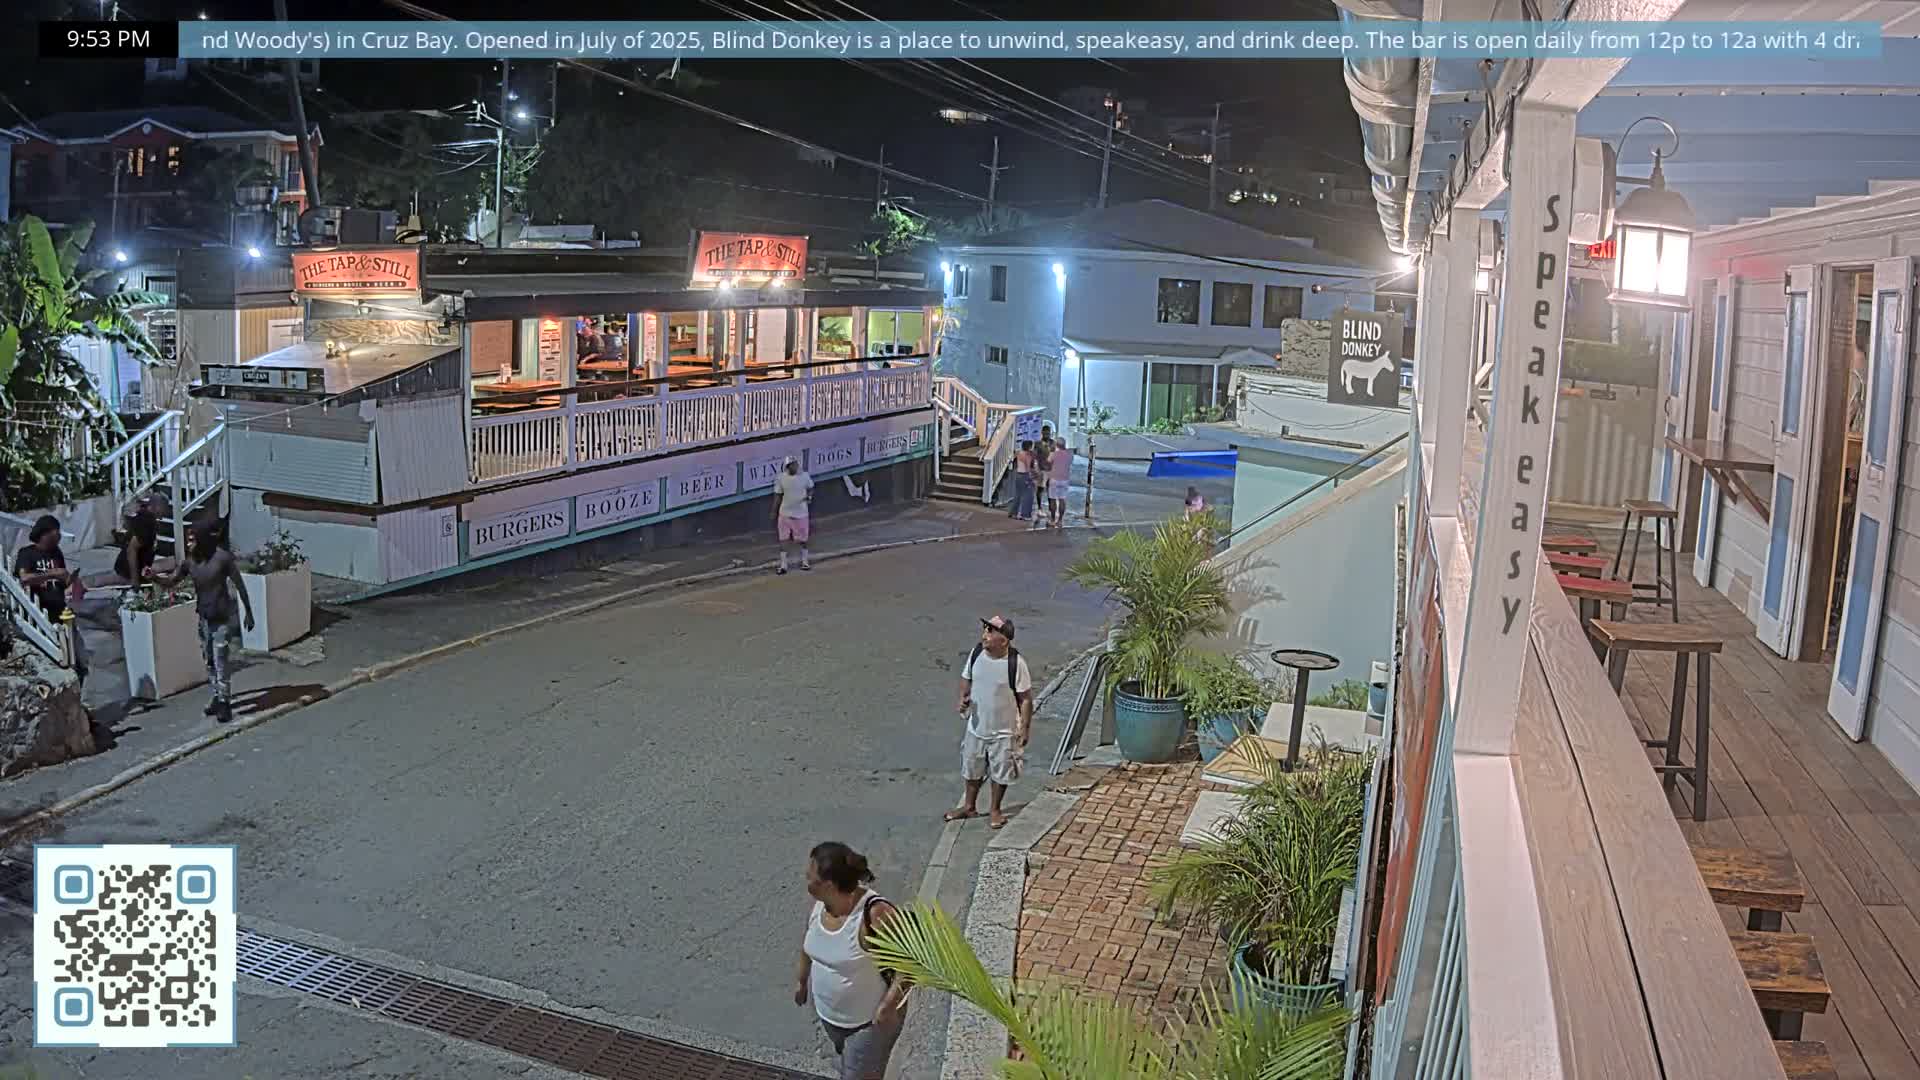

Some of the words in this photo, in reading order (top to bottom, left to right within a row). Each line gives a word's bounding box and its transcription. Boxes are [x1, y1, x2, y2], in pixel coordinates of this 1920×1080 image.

[705, 242, 735, 266] THE
[737, 239, 763, 257] TAP
[761, 240, 775, 257] &
[776, 243, 801, 269] STILL
[300, 260, 327, 280] THE
[328, 256, 355, 272] TAP
[355, 254, 372, 271] &
[372, 257, 411, 280] STILL
[1343, 320, 1382, 341] BLIND
[1341, 341, 1382, 357] DONKEY
[818, 450, 853, 465] DOGS
[680, 474, 725, 496] BEER
[586, 490, 652, 520] BOOZE
[476, 511, 564, 545] BURGERS
